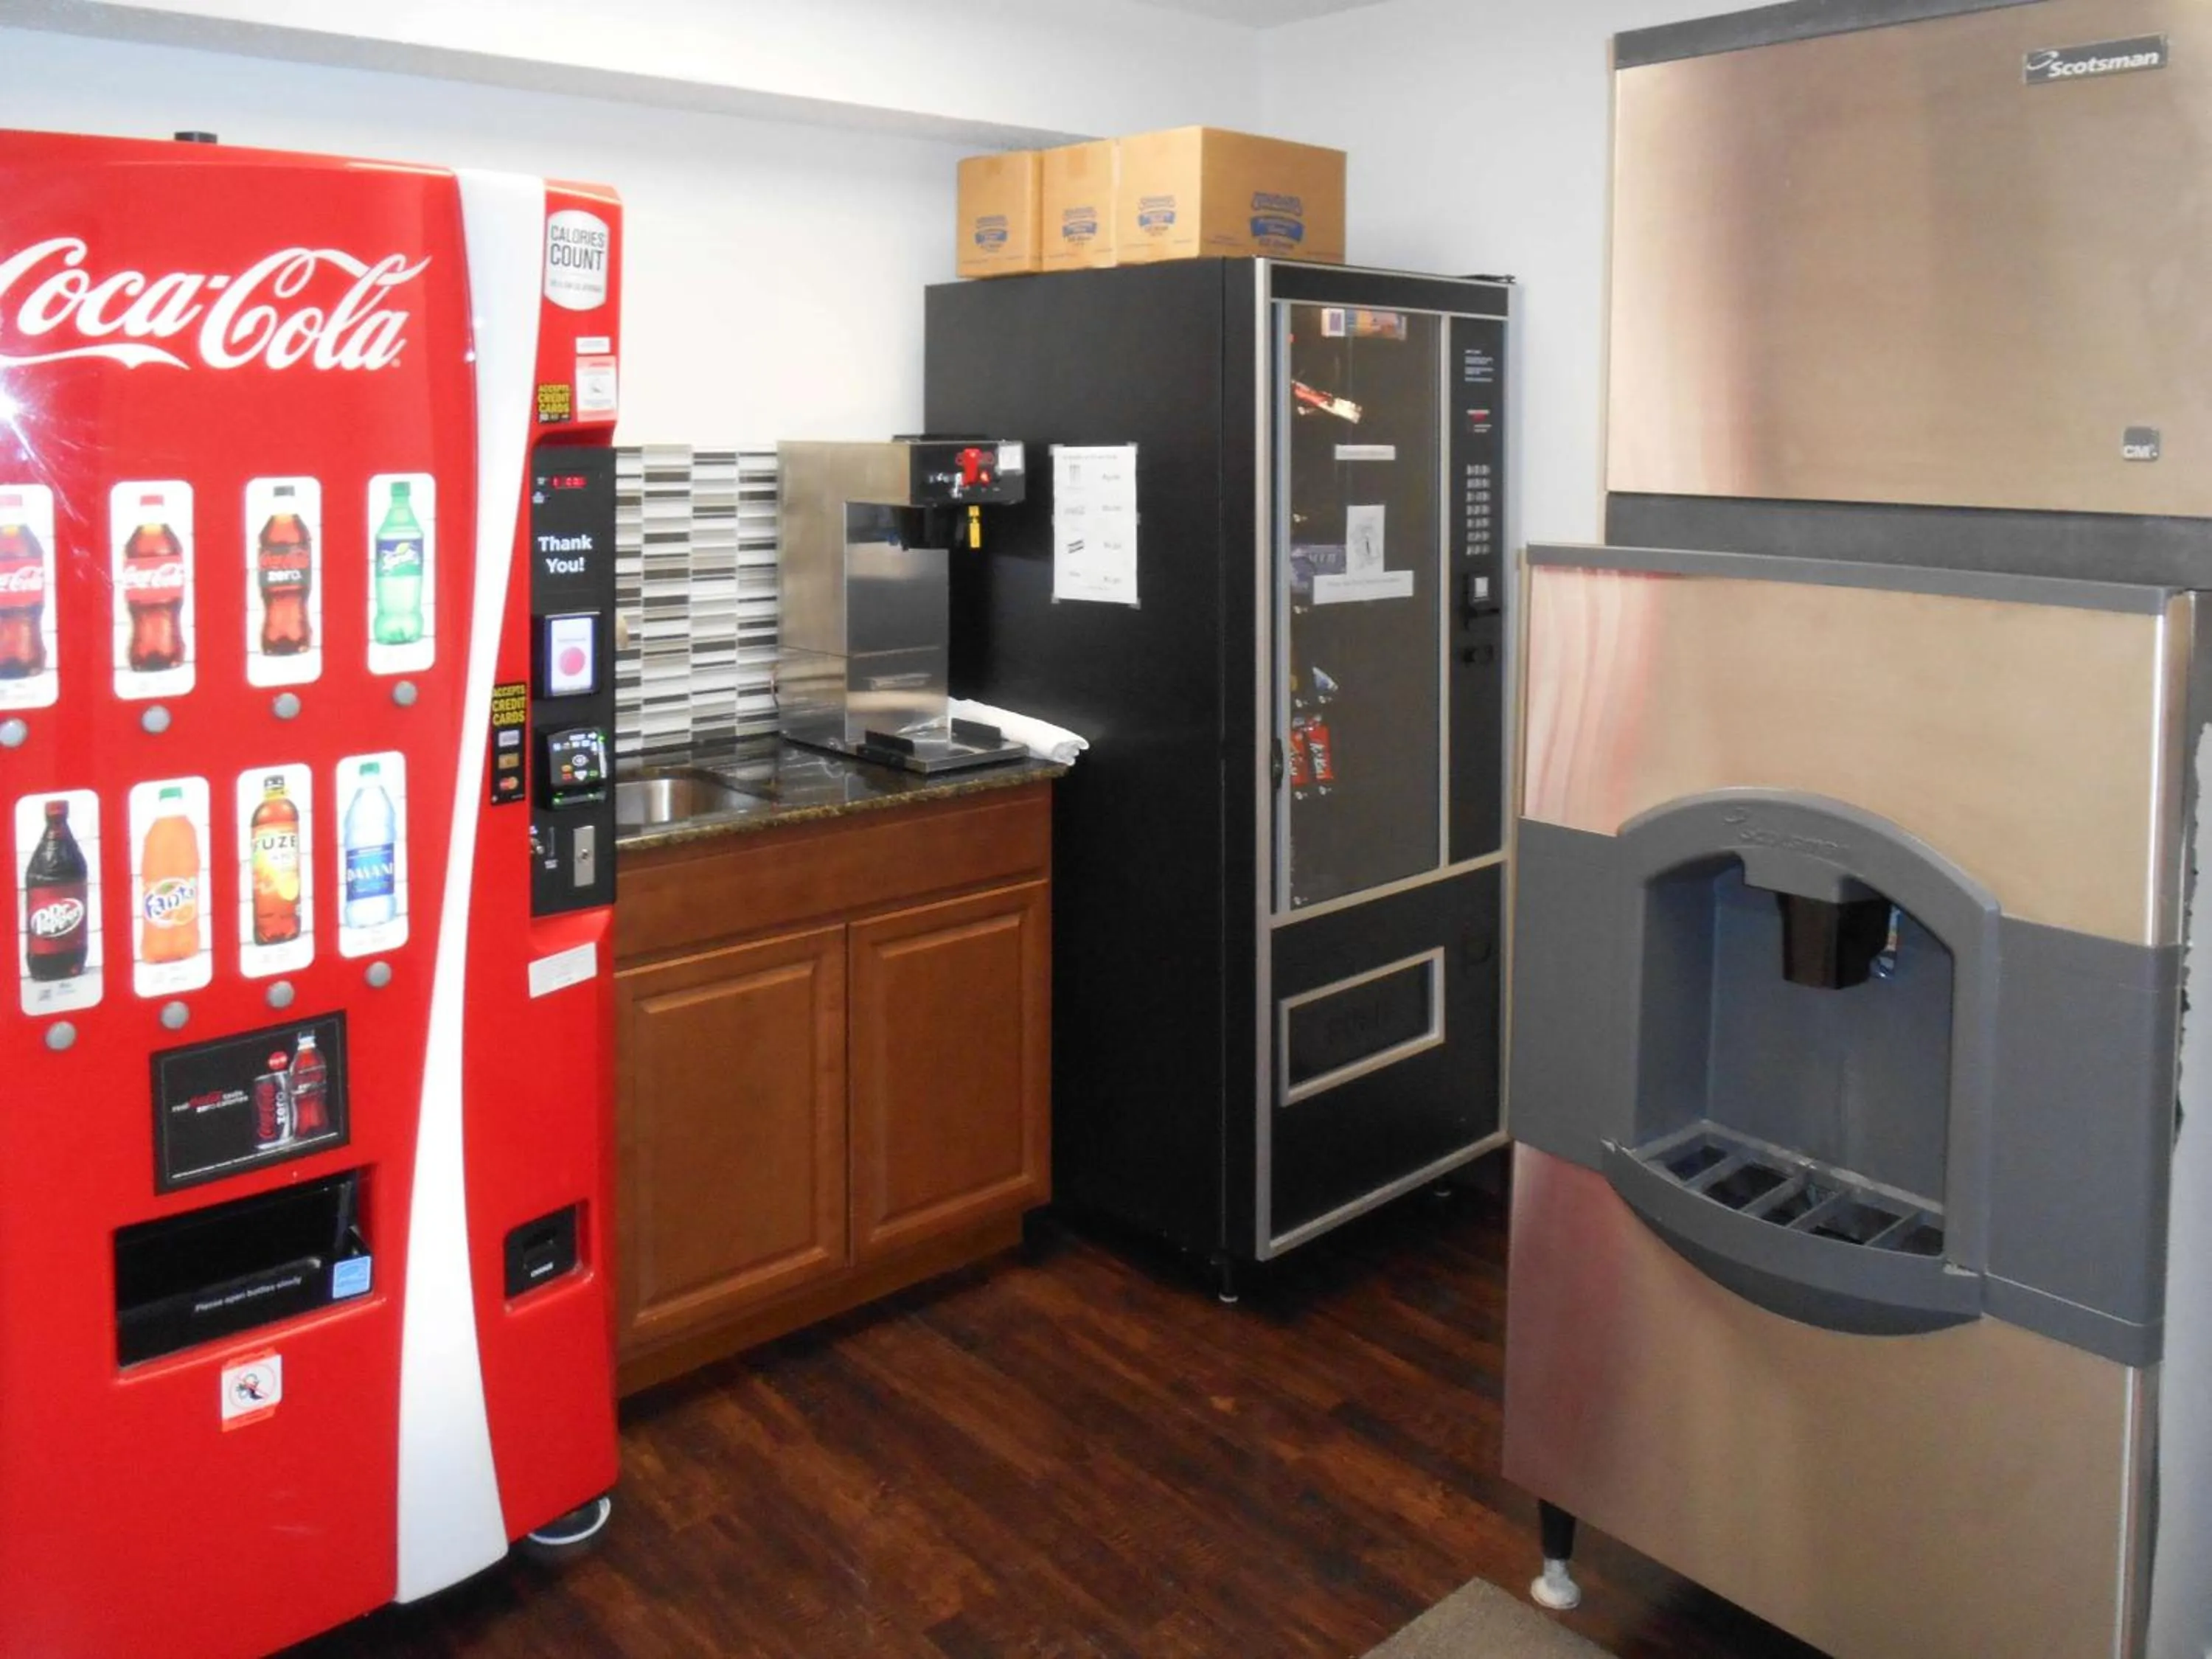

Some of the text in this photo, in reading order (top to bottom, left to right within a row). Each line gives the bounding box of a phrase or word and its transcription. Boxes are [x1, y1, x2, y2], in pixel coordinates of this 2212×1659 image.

[2048, 52, 2160, 78] Scotsman
[551, 225, 605, 248] CALORIES
[549, 244, 604, 271] COUNT
[0, 237, 432, 370] Coca-Cola
[538, 393, 570, 403] CREDIT
[539, 403, 570, 414] CARDS
[538, 535, 593, 552] Thank
[546, 557, 585, 573] You!
[493, 698, 526, 712] CREDIT
[493, 711, 525, 726] CARDS
[195, 1299, 223, 1312] Please
[224, 1292, 246, 1304] open
